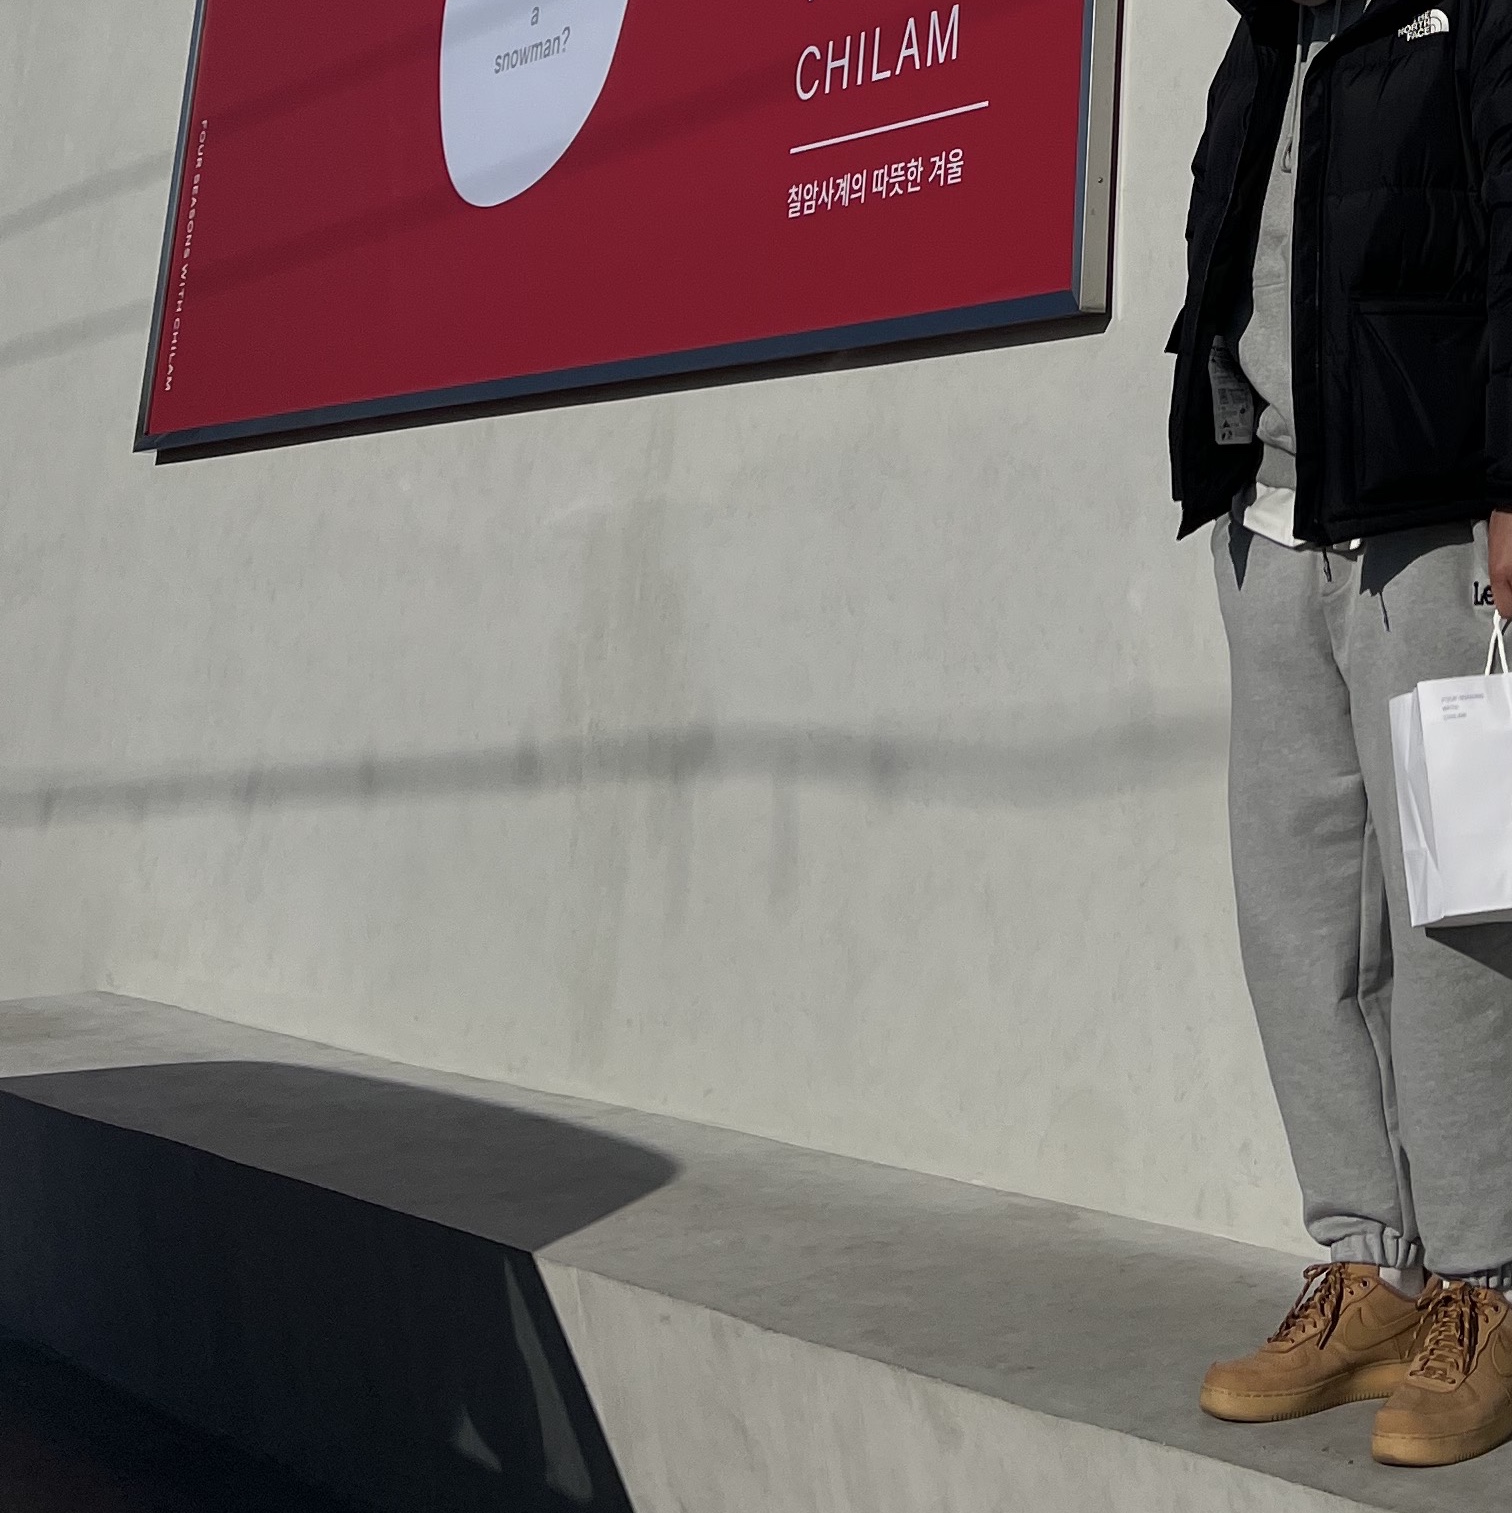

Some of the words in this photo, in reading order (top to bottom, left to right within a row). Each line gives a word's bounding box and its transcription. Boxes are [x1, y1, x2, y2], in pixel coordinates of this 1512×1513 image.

[530, 5, 540, 26] a
[1406, 26, 1431, 42] FACE
[493, 25, 571, 75] snowman?
[795, 3, 961, 102] CHILAM
[195, 119, 208, 169] FOUR
[787, 168, 867, 219] 칠암사계의
[871, 156, 924, 199] 따뜻한
[928, 148, 965, 187] 겨울
[174, 263, 189, 313] WITH
[164, 317, 181, 391] CHILAM
[1473, 580, 1495, 606] Le
